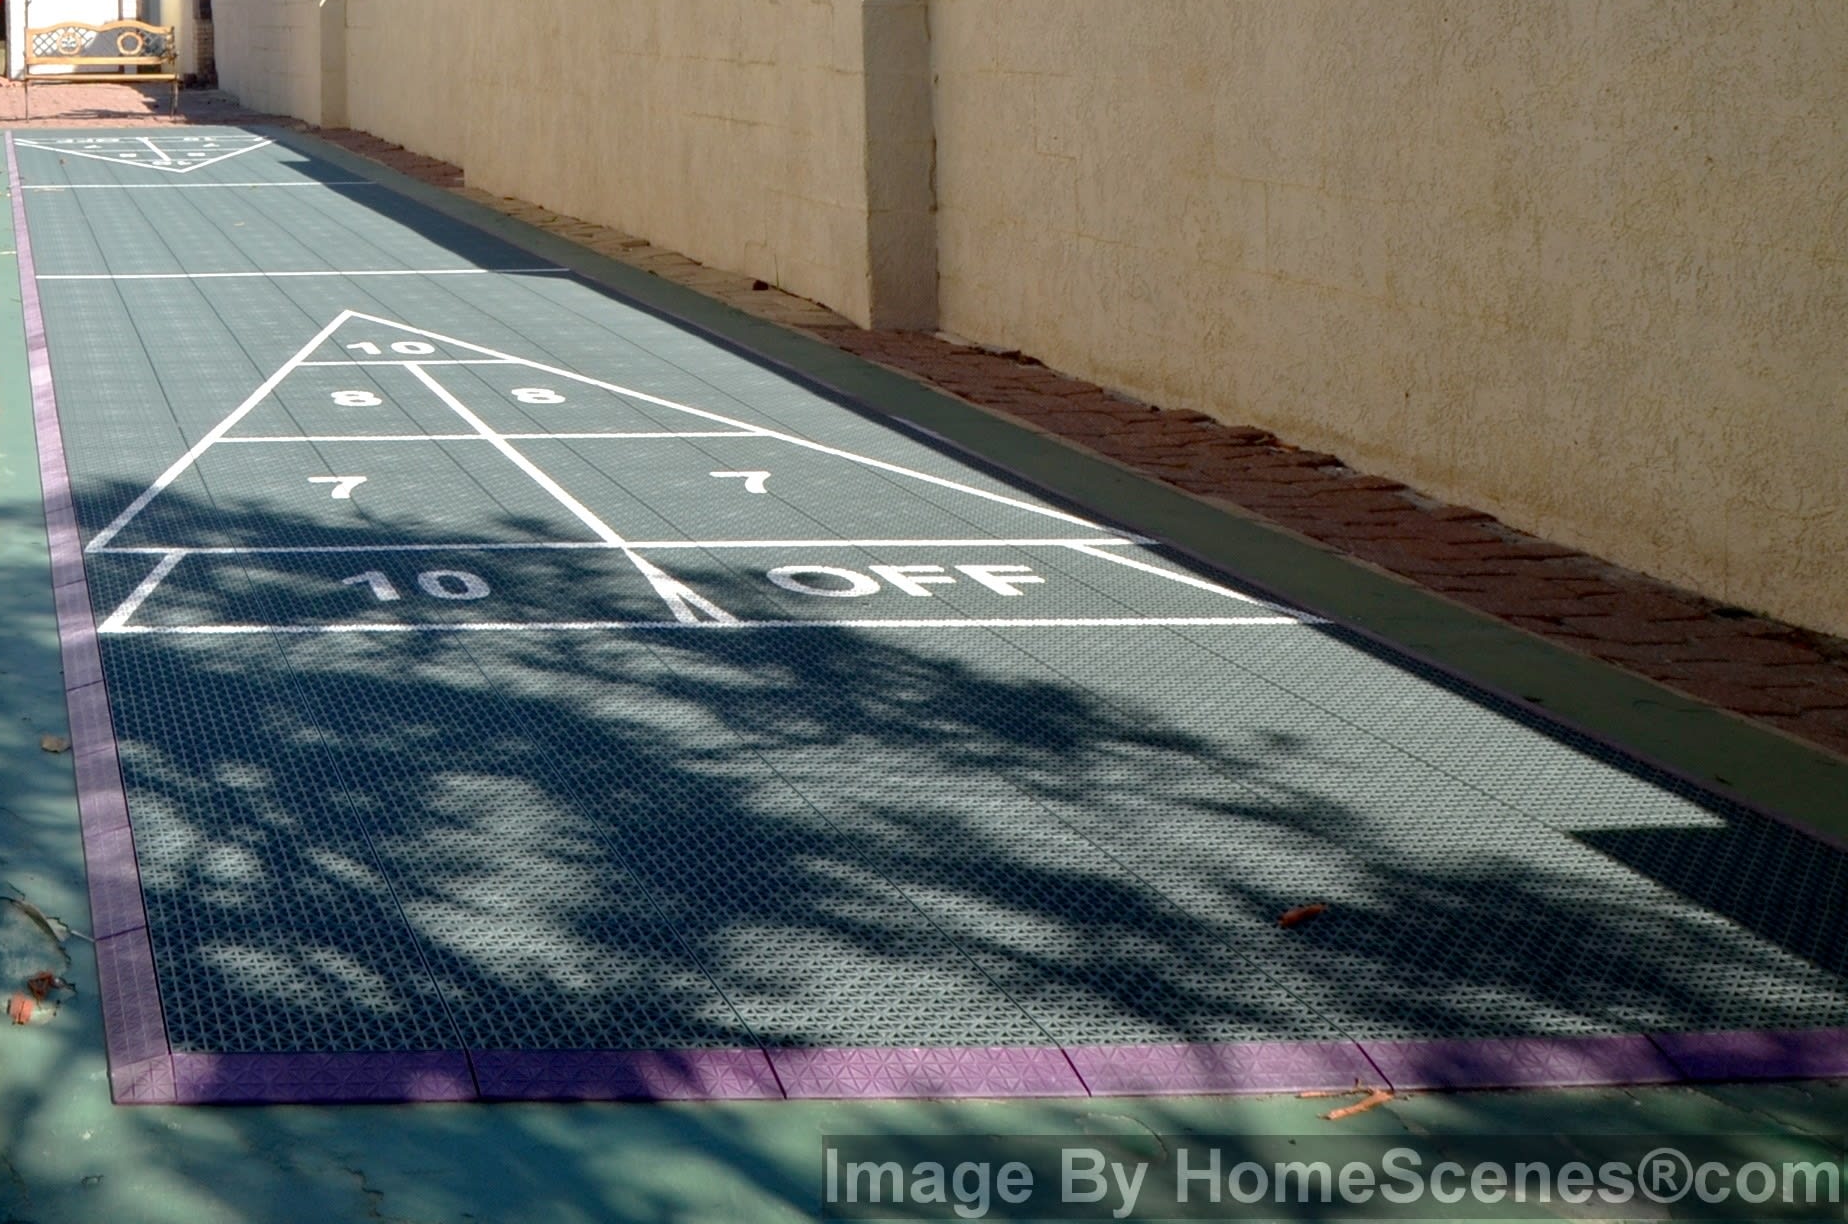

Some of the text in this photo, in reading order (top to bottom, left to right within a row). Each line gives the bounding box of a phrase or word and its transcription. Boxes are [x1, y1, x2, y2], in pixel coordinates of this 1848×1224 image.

[345, 341, 437, 355] 10
[330, 390, 383, 406] 8
[510, 387, 566, 404] 8
[307, 476, 368, 499] 7
[708, 470, 771, 494] 7
[341, 570, 491, 600] 10
[767, 564, 1045, 597] OFF
